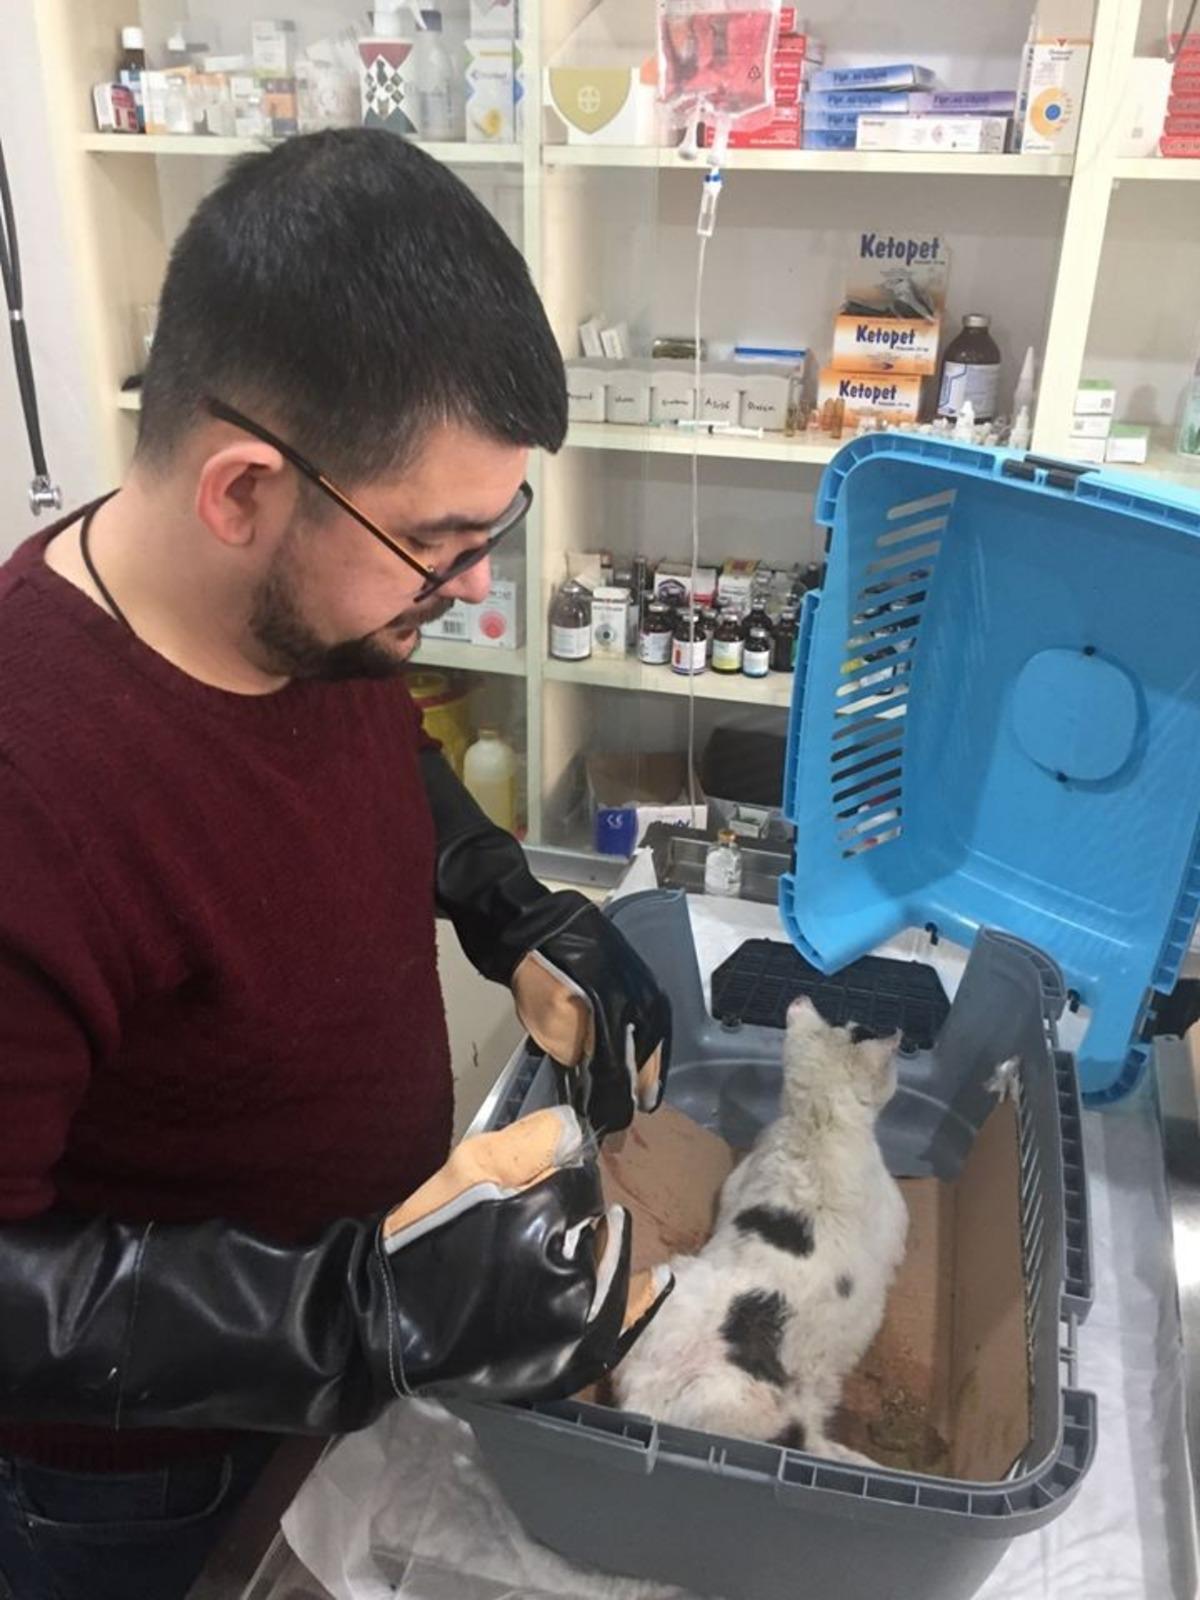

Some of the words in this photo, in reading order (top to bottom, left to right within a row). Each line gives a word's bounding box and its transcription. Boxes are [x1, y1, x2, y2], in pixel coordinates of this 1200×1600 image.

[861, 233, 940, 266] Ketopet
[856, 324, 916, 349] Ketopet
[839, 380, 897, 404] Ketopet
